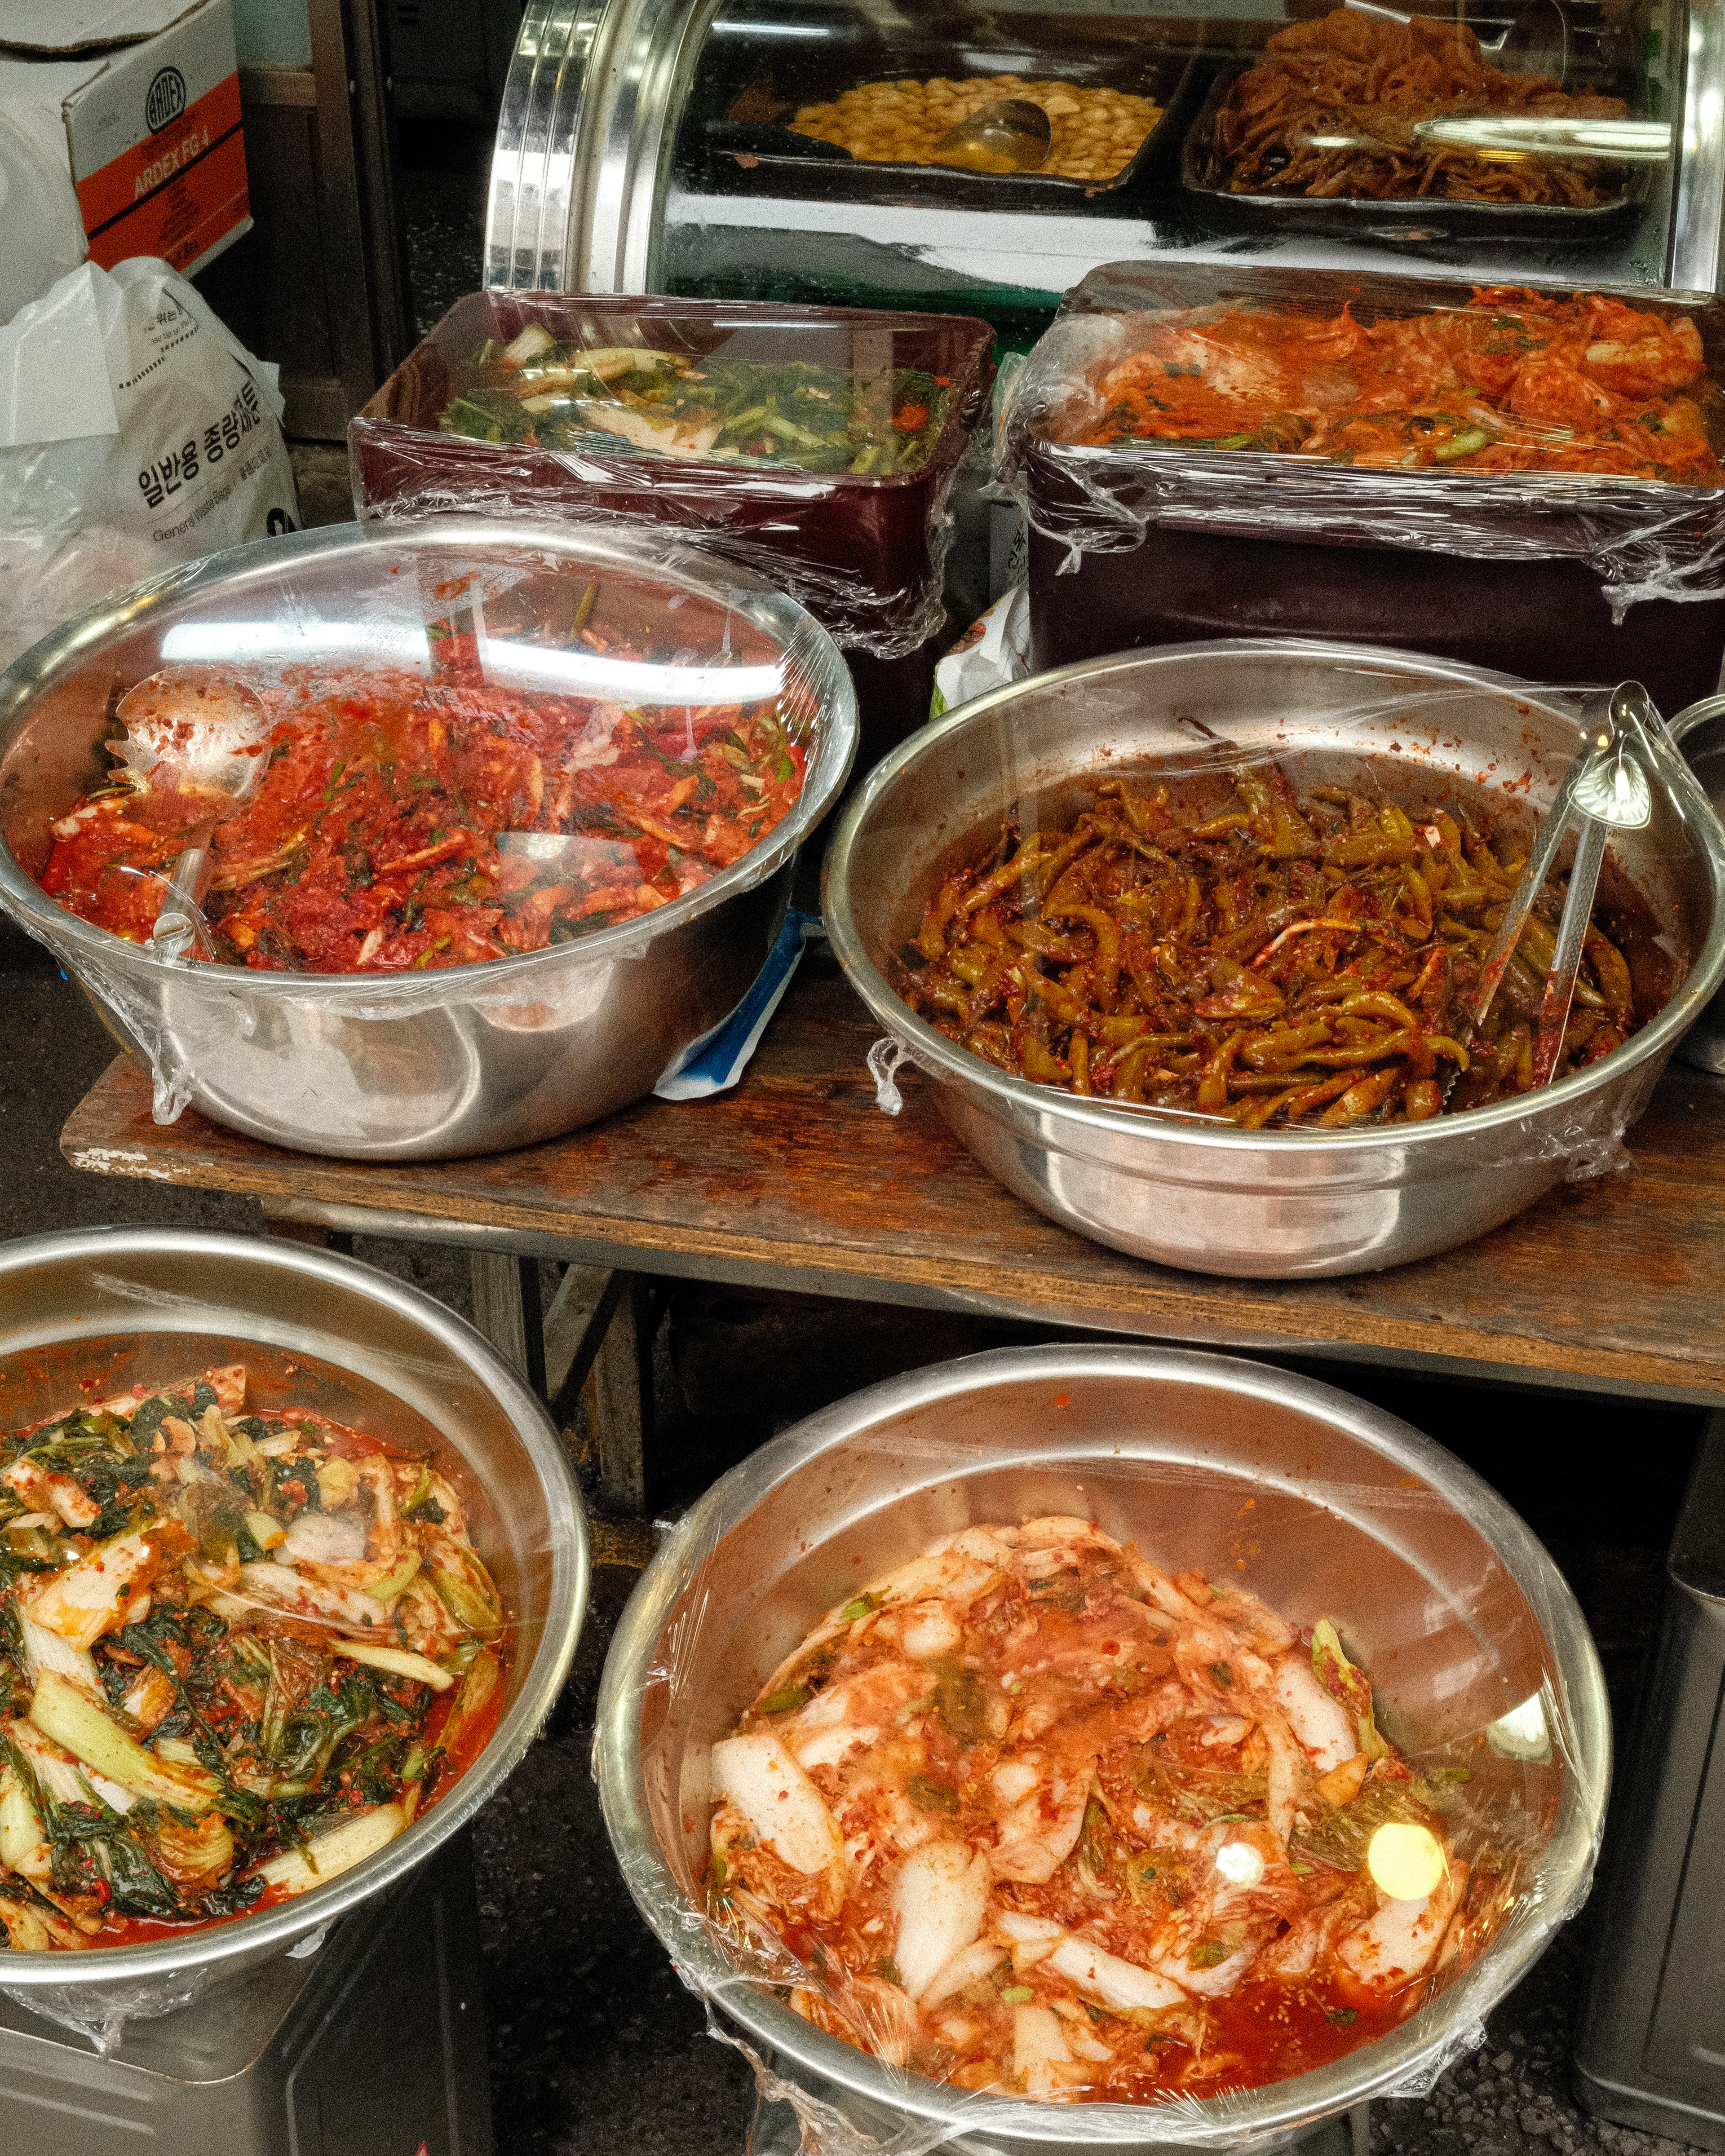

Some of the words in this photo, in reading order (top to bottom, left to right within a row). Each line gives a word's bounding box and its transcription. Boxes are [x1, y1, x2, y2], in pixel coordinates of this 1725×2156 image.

[149, 74, 184, 126] ARDEX
[135, 147, 180, 199] ARDEX
[182, 134, 199, 164] FG
[139, 441, 199, 509] 일반용
[204, 382, 261, 463] 종량제투
[153, 513, 196, 542] General
[192, 498, 215, 521] Waste
